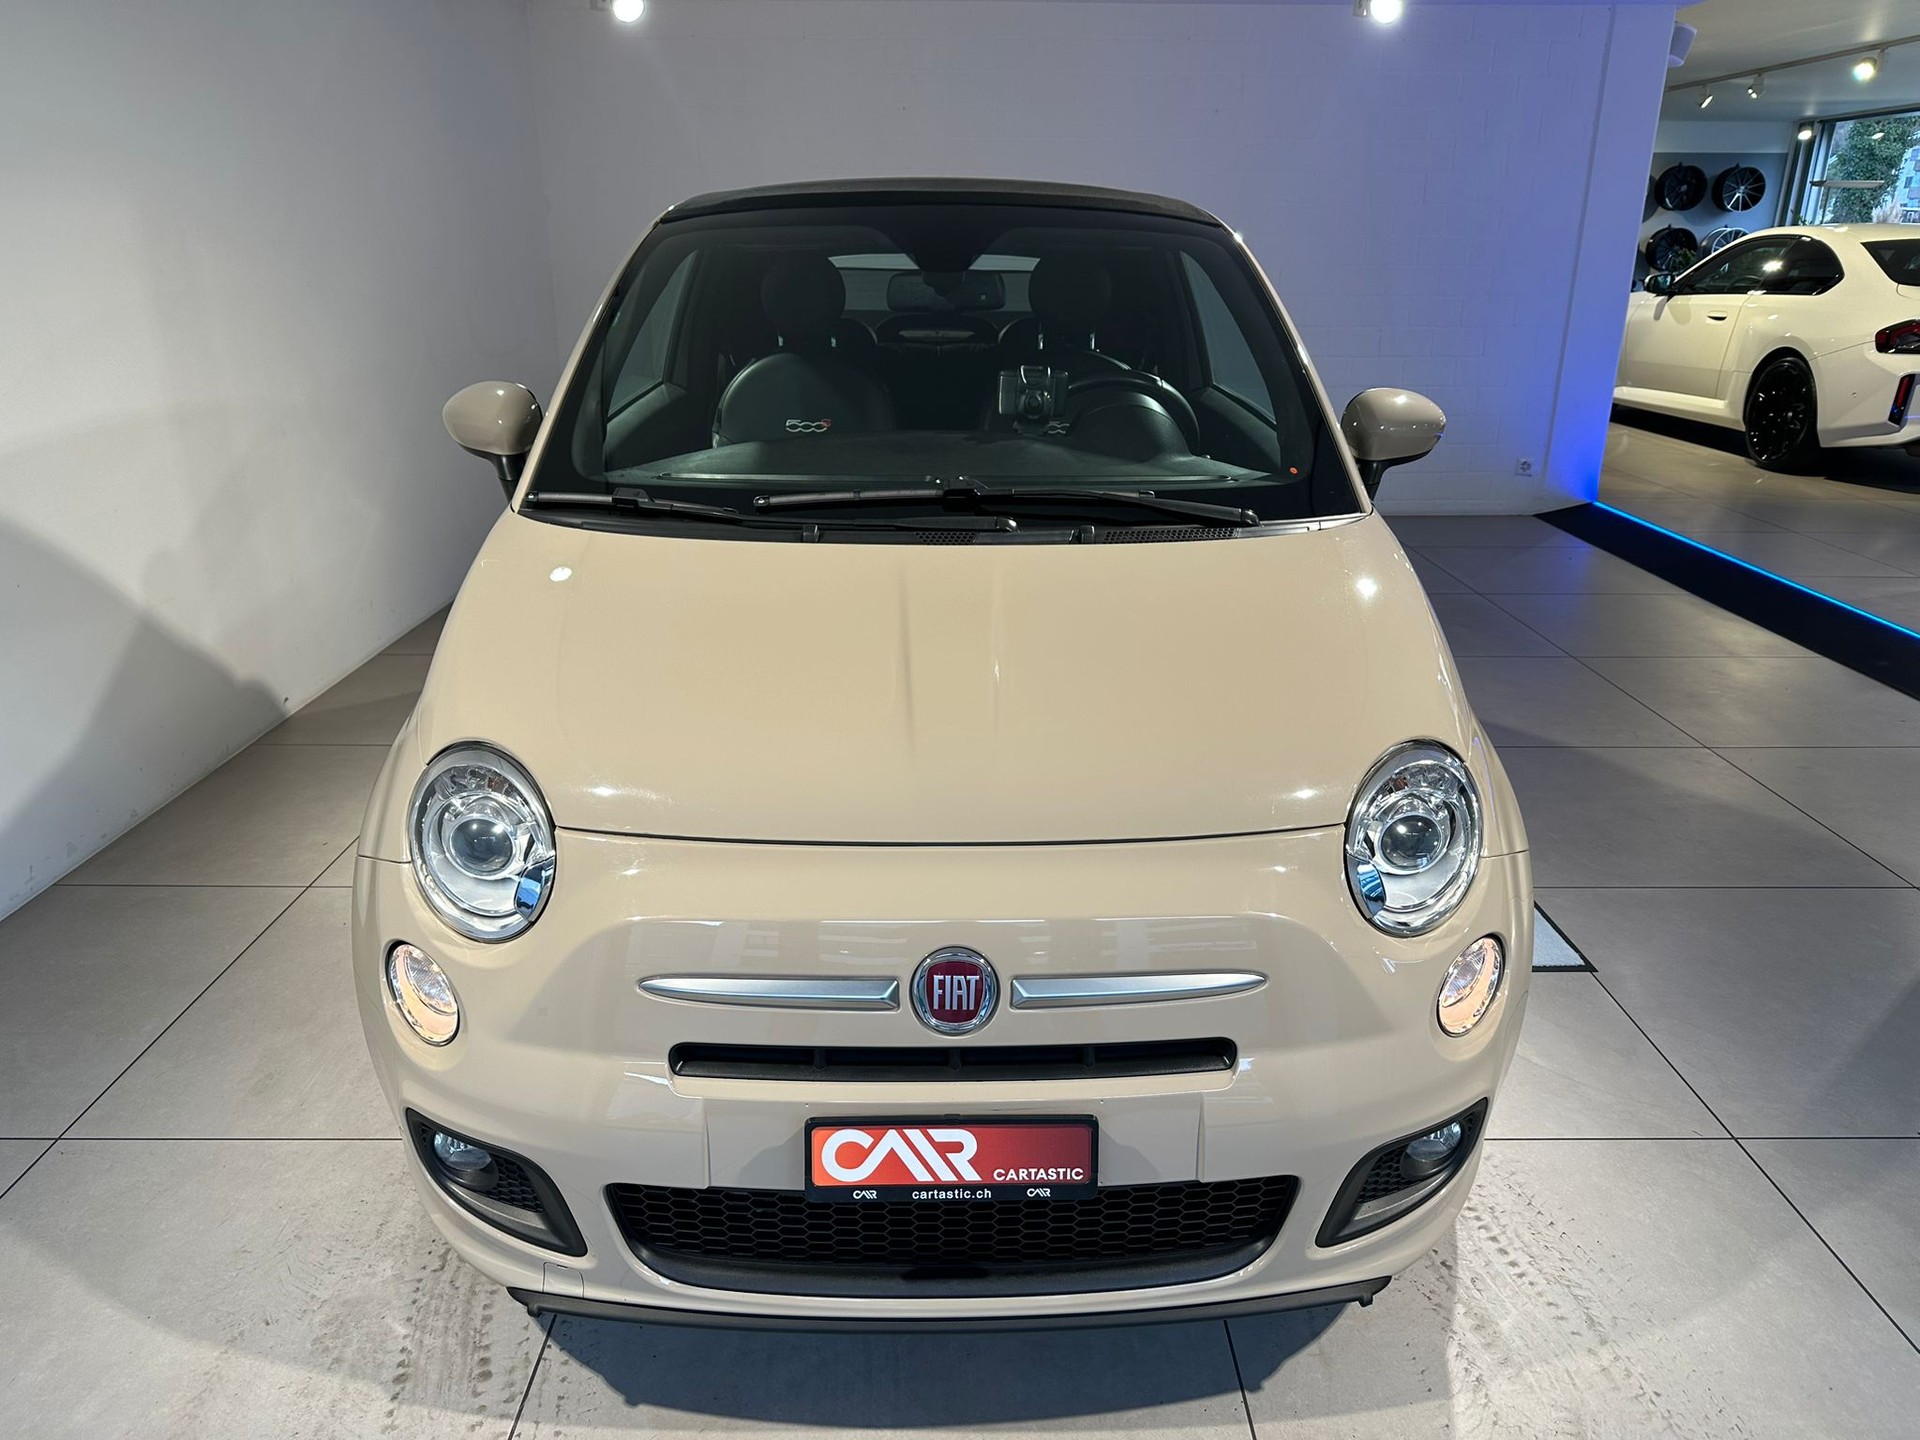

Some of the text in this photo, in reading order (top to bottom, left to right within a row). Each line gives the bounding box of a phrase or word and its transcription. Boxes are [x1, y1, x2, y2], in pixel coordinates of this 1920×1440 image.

[933, 975, 980, 1010] FIAT
[993, 1167, 1084, 1181] CARTASTIC
[912, 1189, 992, 1199] cartastic.ch
